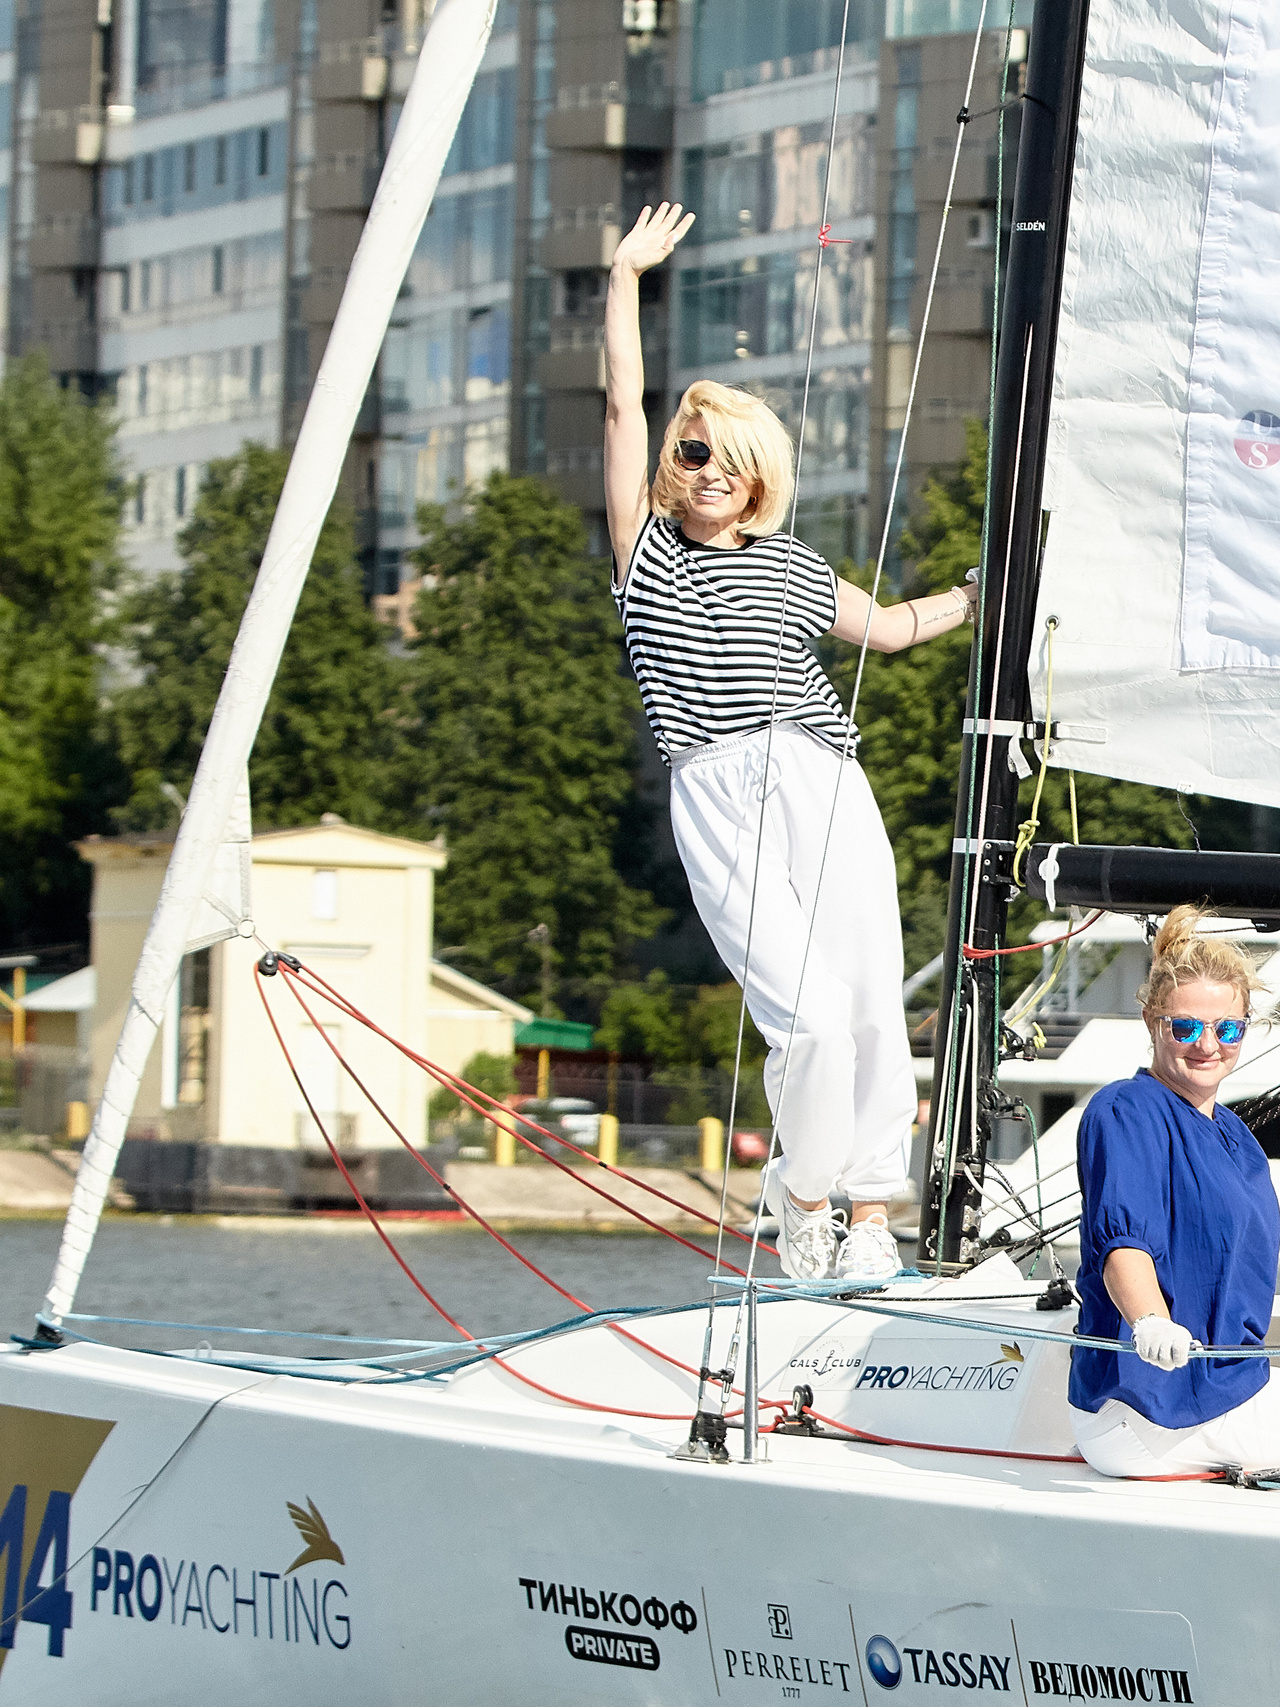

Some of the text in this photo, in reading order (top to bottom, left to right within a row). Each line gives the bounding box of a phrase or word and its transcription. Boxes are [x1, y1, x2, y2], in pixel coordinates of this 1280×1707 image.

[1016, 220, 1046, 231] SELDÉN
[831, 1358, 862, 1368] CLUB
[855, 1365, 1018, 1390] PROYACHTING
[90, 1546, 351, 1650] PROYACHTING
[518, 1577, 698, 1635] ТИНЬКОФФ
[571, 1631, 656, 1665] PRIVATE
[723, 1648, 850, 1692] PERRELET
[902, 1647, 1011, 1691] TASSAY
[1029, 1660, 1195, 1705] ВЕДОМОСТИ
